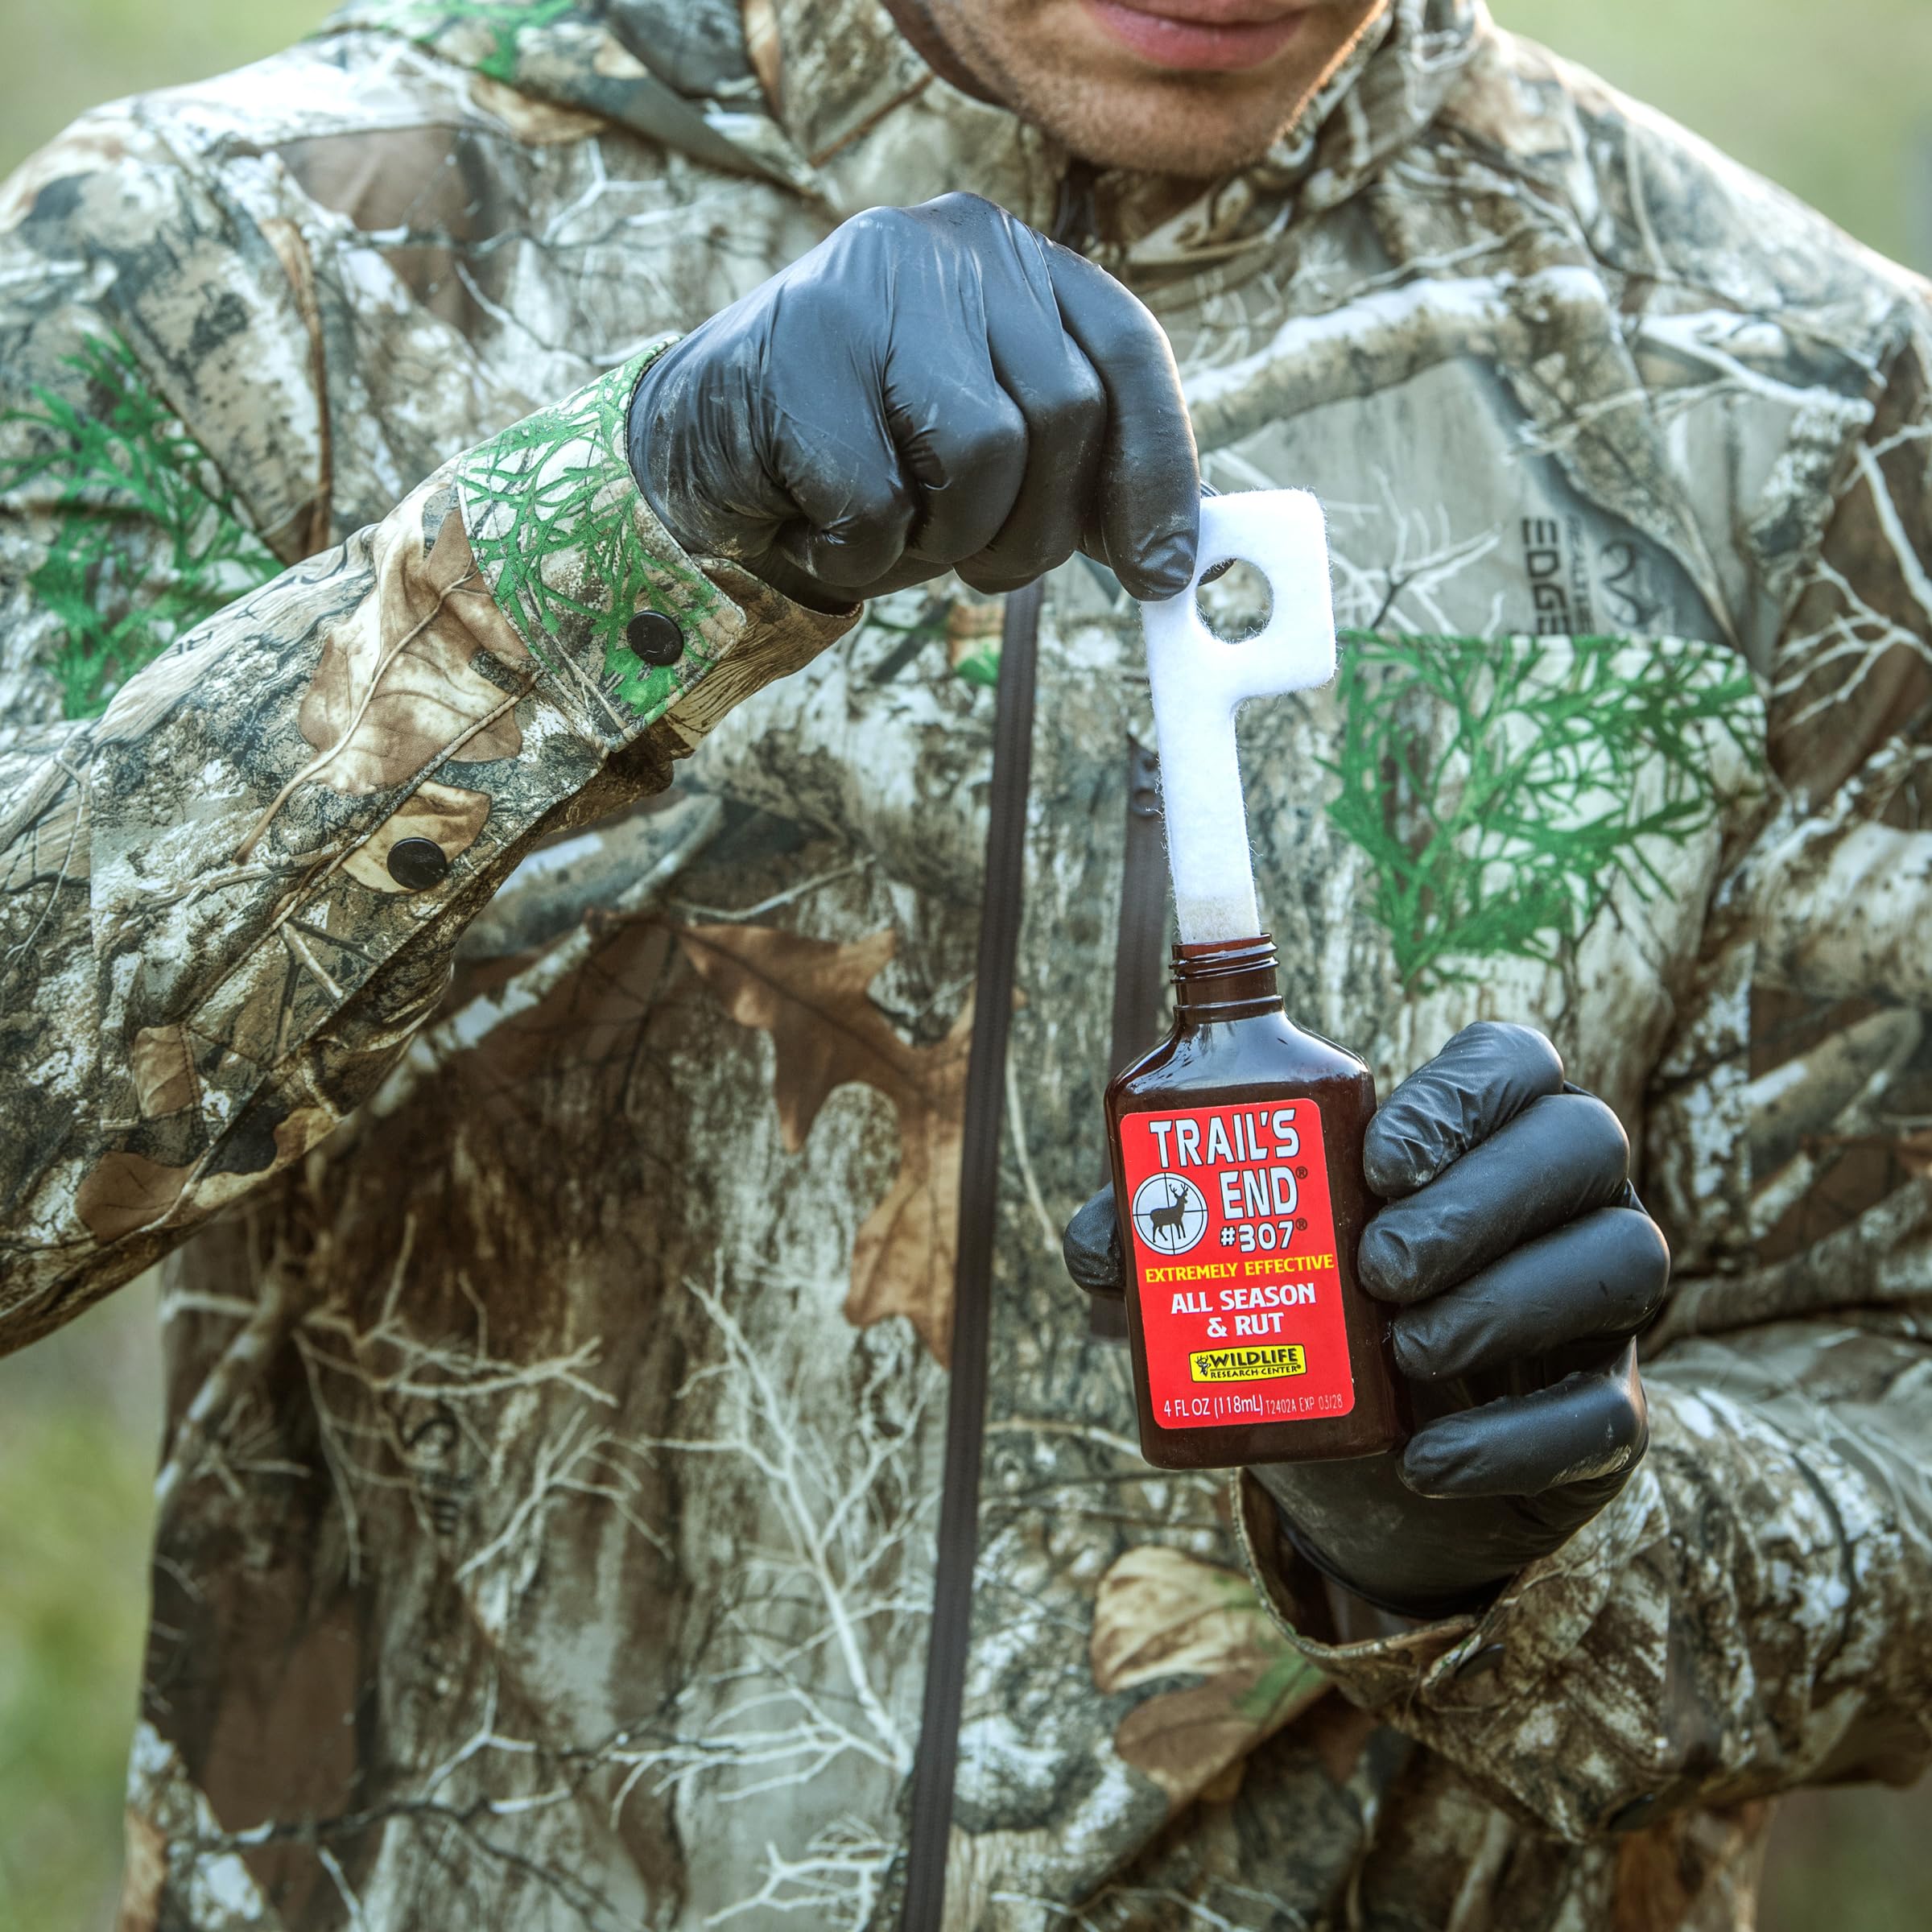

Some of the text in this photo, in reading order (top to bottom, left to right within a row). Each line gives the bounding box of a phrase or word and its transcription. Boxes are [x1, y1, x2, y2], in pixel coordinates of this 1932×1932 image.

[1521, 517, 1572, 635] EDGE
[1149, 1108, 1300, 1169] TRAIL'S
[1146, 1253, 1335, 1283] EXTREMELY EFFECTIVE
[1170, 1282, 1317, 1315] ALL SEASON
[1206, 1312, 1285, 1338] & RUT
[1209, 1348, 1298, 1367] WILDLIFE
[1210, 1369, 1258, 1379] RESEARCH
[1163, 1393, 1344, 1419] 4 FL OZ (118mL) T2402A EXP 03/28
